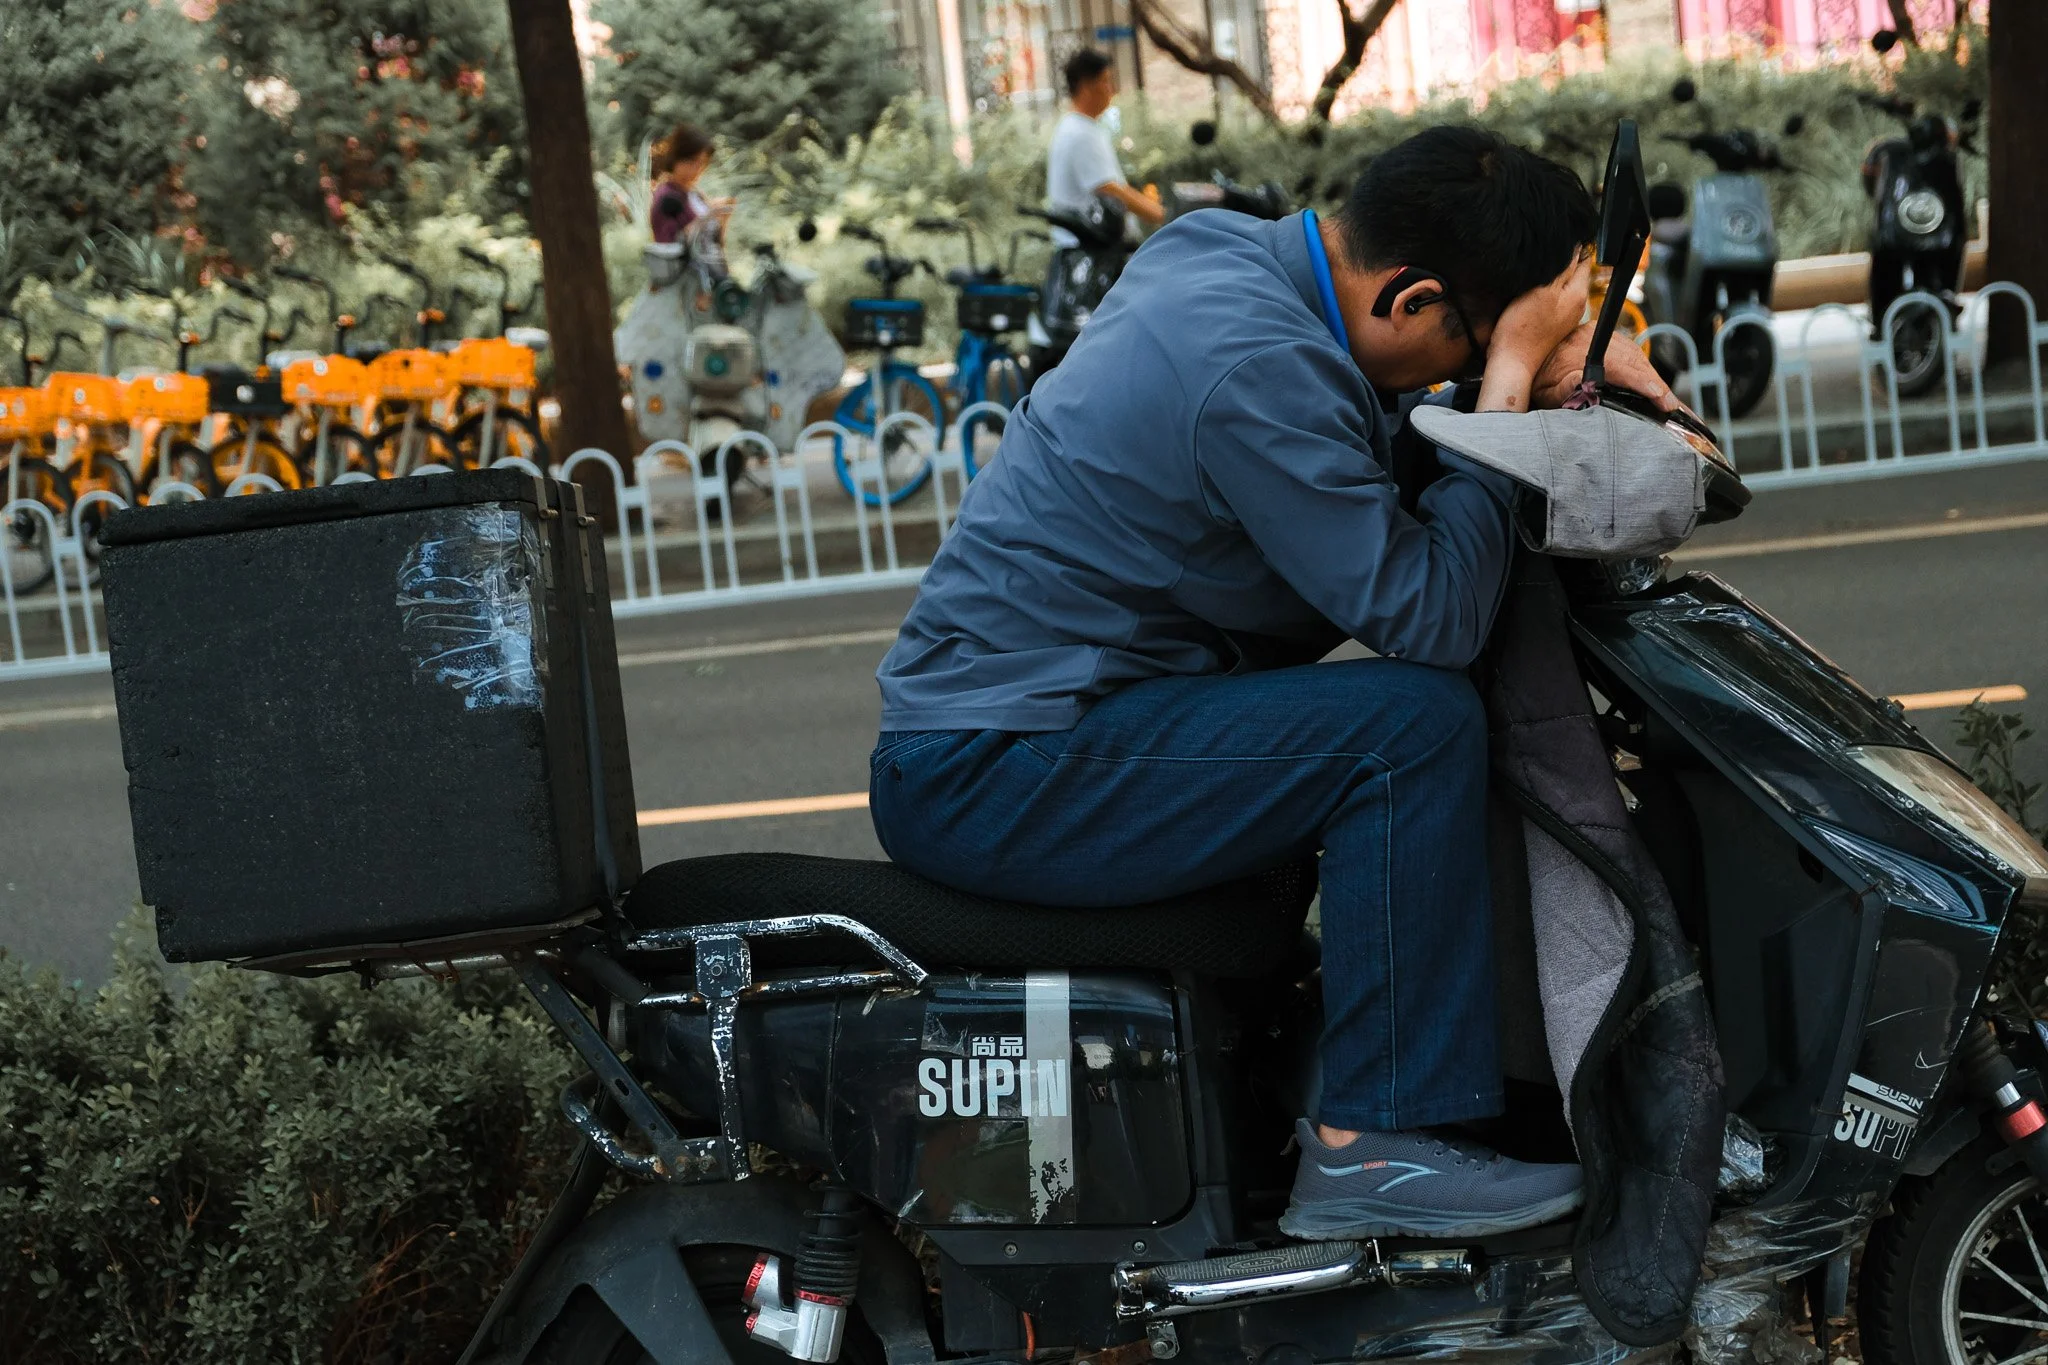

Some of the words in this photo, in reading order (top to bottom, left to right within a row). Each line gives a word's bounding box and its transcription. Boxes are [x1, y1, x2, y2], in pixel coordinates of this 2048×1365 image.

[972, 1036, 1024, 1057] 尚品
[918, 1057, 1068, 1117] SUPIN
[1877, 1085, 1924, 1110] SUPIN
